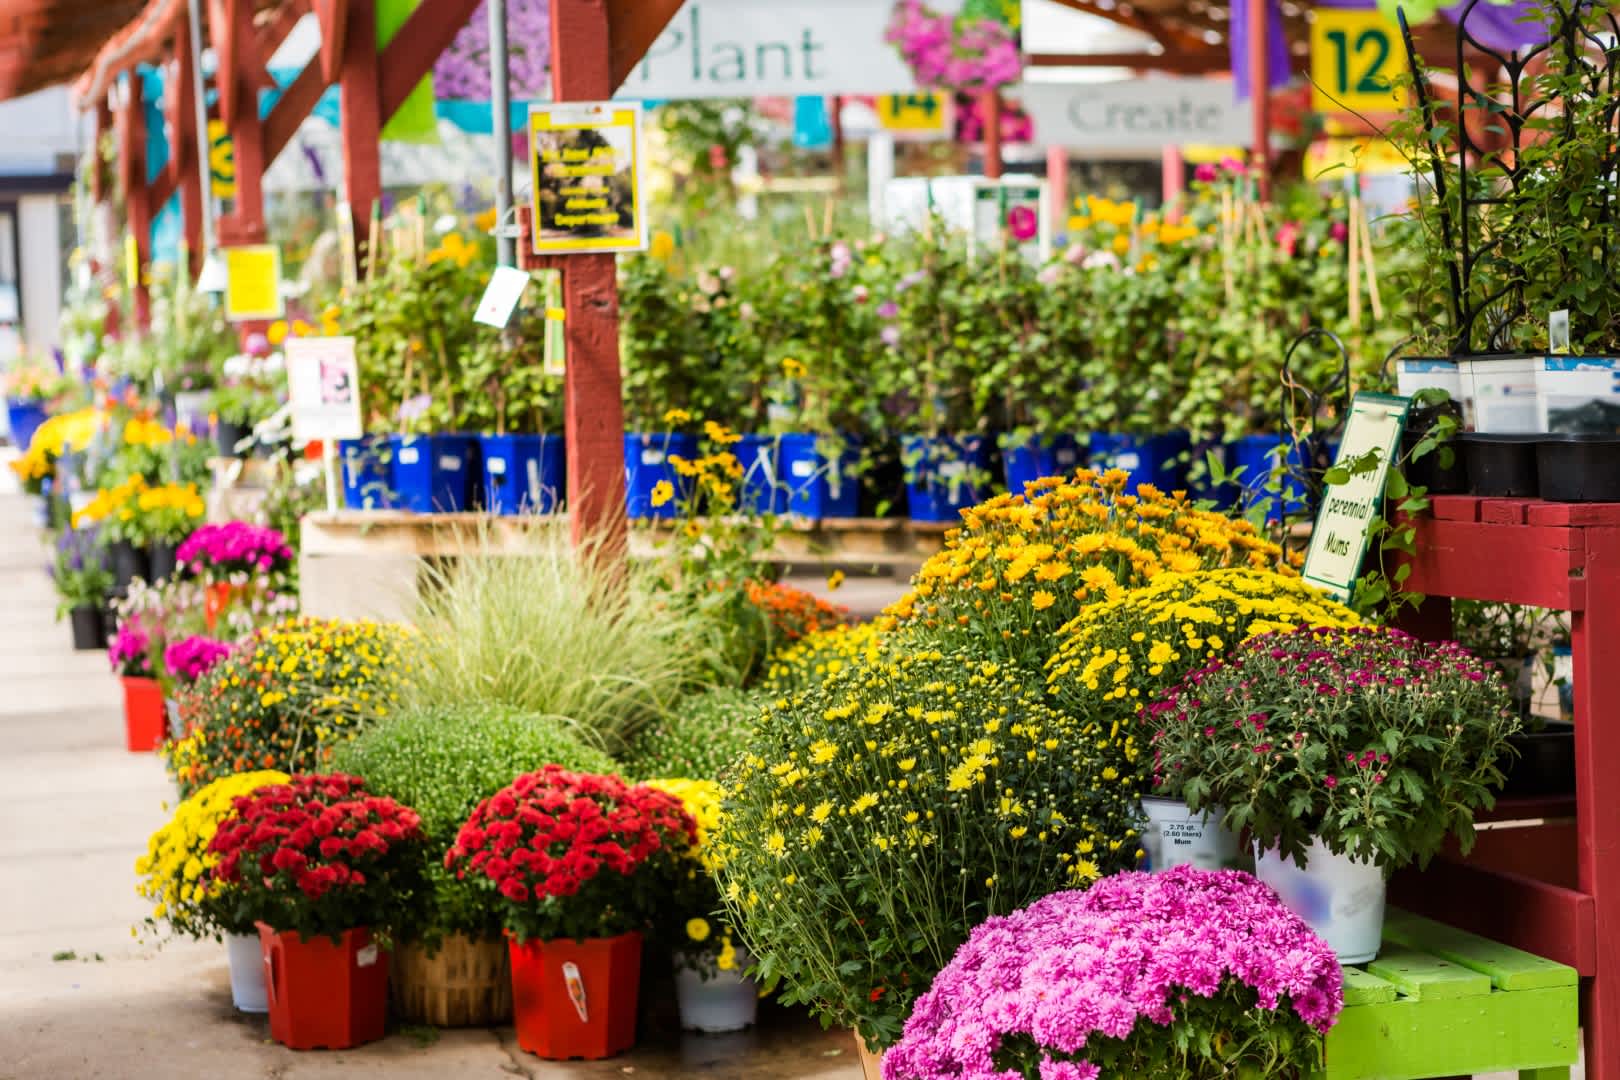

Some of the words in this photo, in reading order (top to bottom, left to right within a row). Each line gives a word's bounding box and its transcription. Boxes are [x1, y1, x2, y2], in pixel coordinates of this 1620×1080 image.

[640, 4, 827, 81] Plant
[1324, 28, 1391, 94] 12
[1067, 90, 1221, 134] Create
[1327, 497, 1369, 520] perennial
[1323, 531, 1350, 556] Mums
